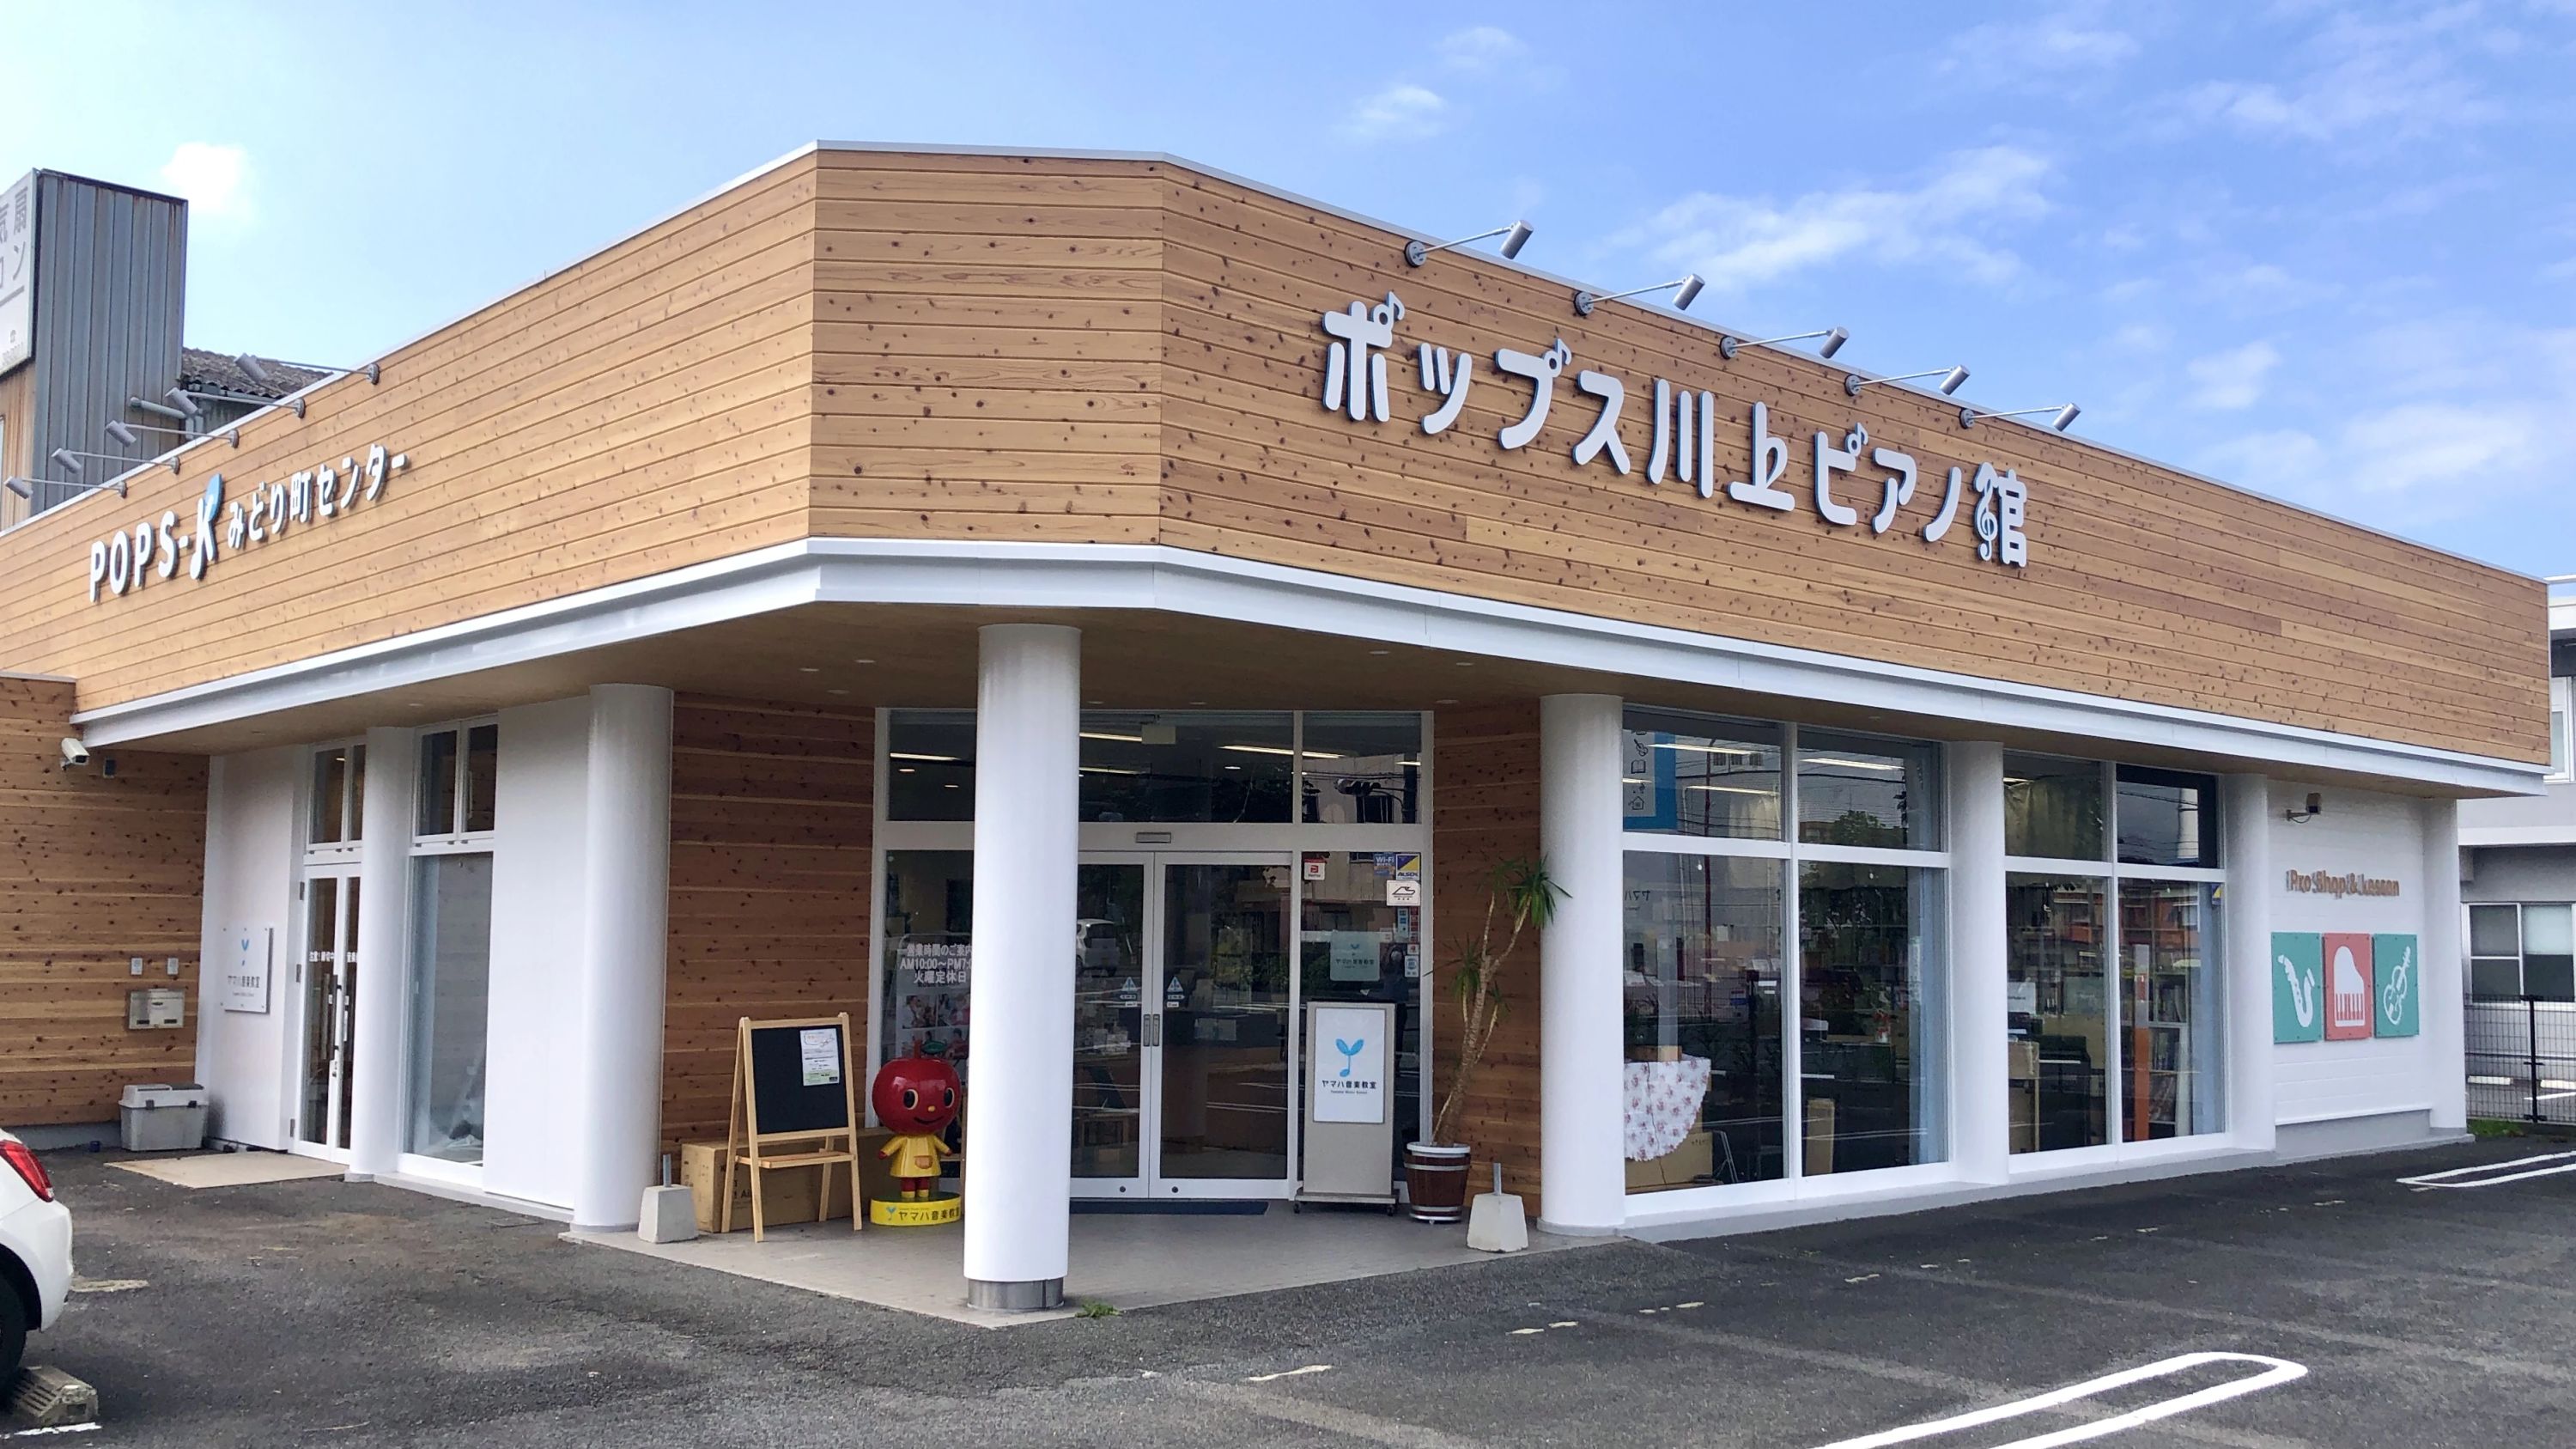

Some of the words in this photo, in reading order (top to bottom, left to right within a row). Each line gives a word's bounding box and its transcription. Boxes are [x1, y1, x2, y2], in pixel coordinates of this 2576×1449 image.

[1321, 290, 2028, 569] ポップス川上ピアノ館
[228, 443, 408, 551] みどり町センター
[2286, 869, 2312, 893] Pro
[2312, 870, 2346, 899] Shop
[914, 971, 967, 983] 火曜定休日
[1321, 1080, 1376, 1089] ヤマハ音楽教室
